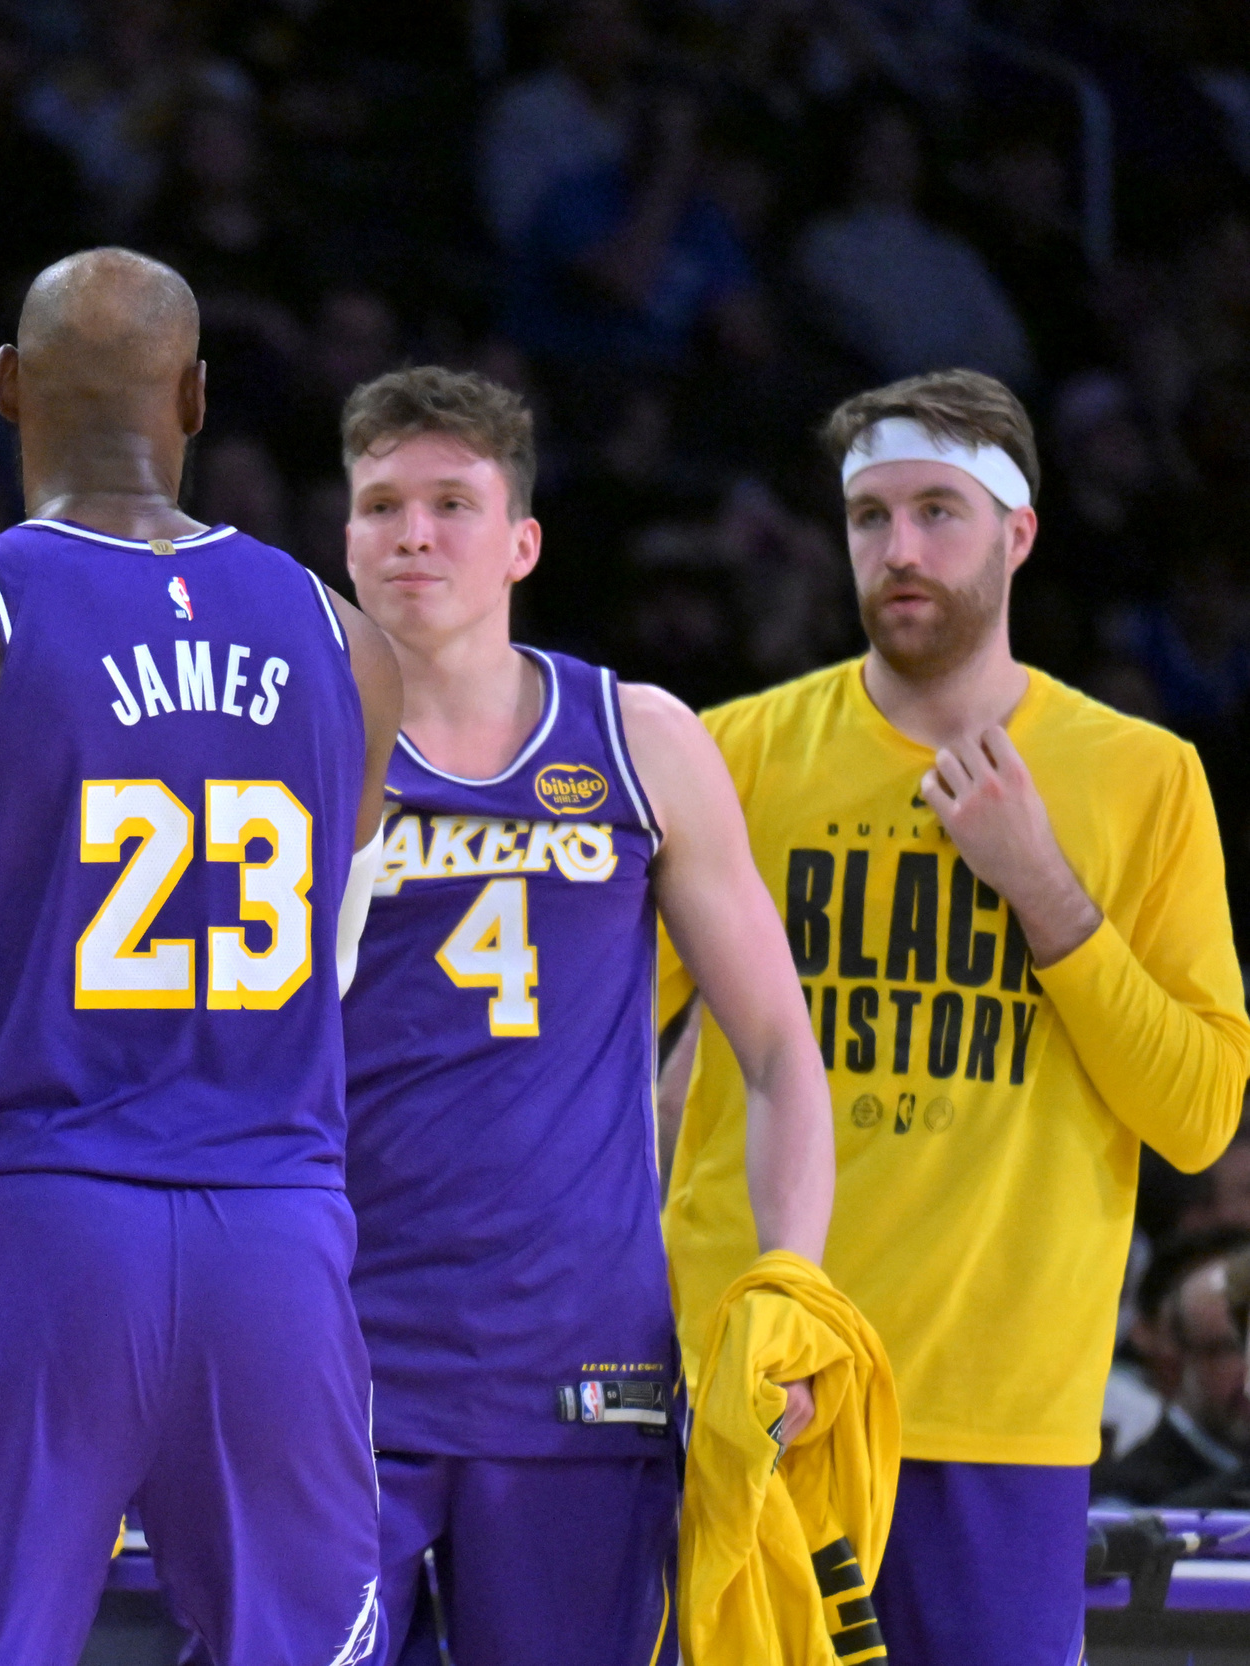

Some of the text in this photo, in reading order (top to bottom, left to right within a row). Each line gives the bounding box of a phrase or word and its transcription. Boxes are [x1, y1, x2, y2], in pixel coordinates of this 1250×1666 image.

[101, 640, 290, 726] JAMES
[540, 777, 603, 799] bibigo
[74, 779, 313, 1011] 23
[372, 802, 618, 897] AKERS
[434, 877, 540, 1037] 4
[803, 985, 1039, 1086] ISTORY
